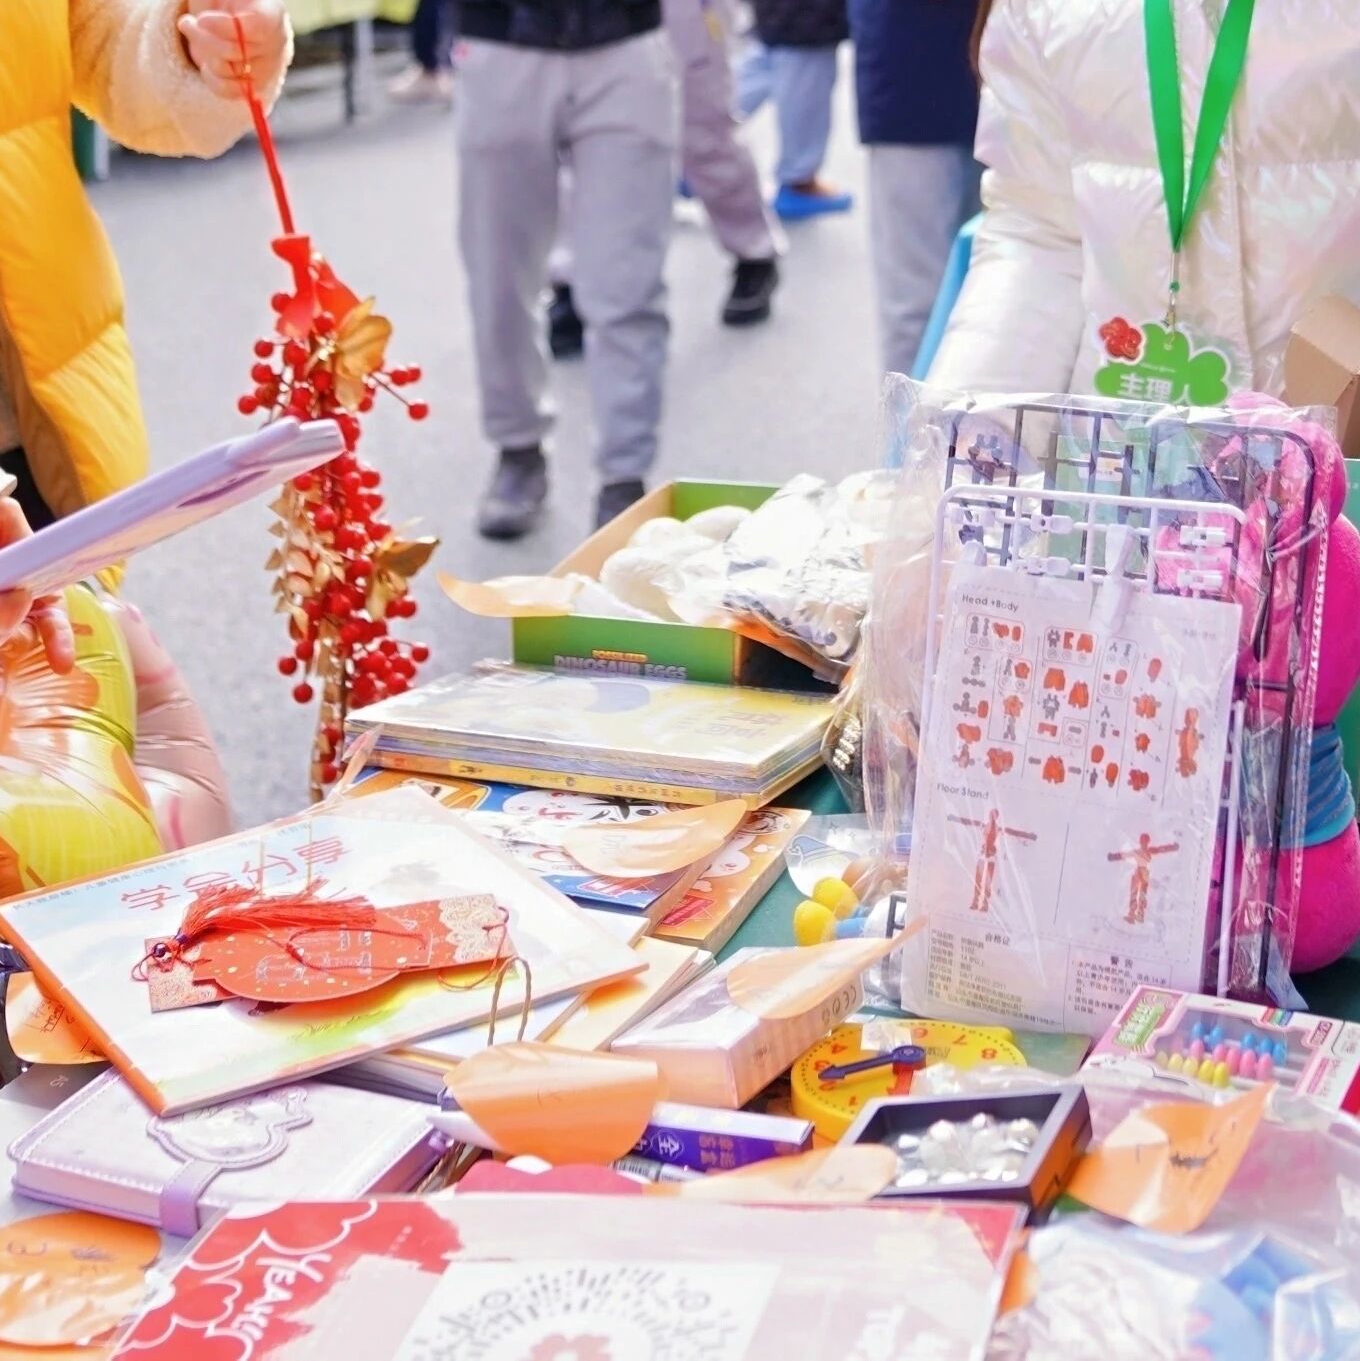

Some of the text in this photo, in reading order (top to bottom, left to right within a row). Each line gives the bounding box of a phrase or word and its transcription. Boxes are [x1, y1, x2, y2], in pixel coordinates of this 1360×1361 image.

[961, 593, 988, 606] Head
[554, 654, 688, 680] DINOSAUR EGGS
[936, 782, 990, 801] Floor Stand
[952, 1034, 968, 1046] 7
[830, 1043, 848, 1055] 4
[981, 1048, 998, 1060] 8
